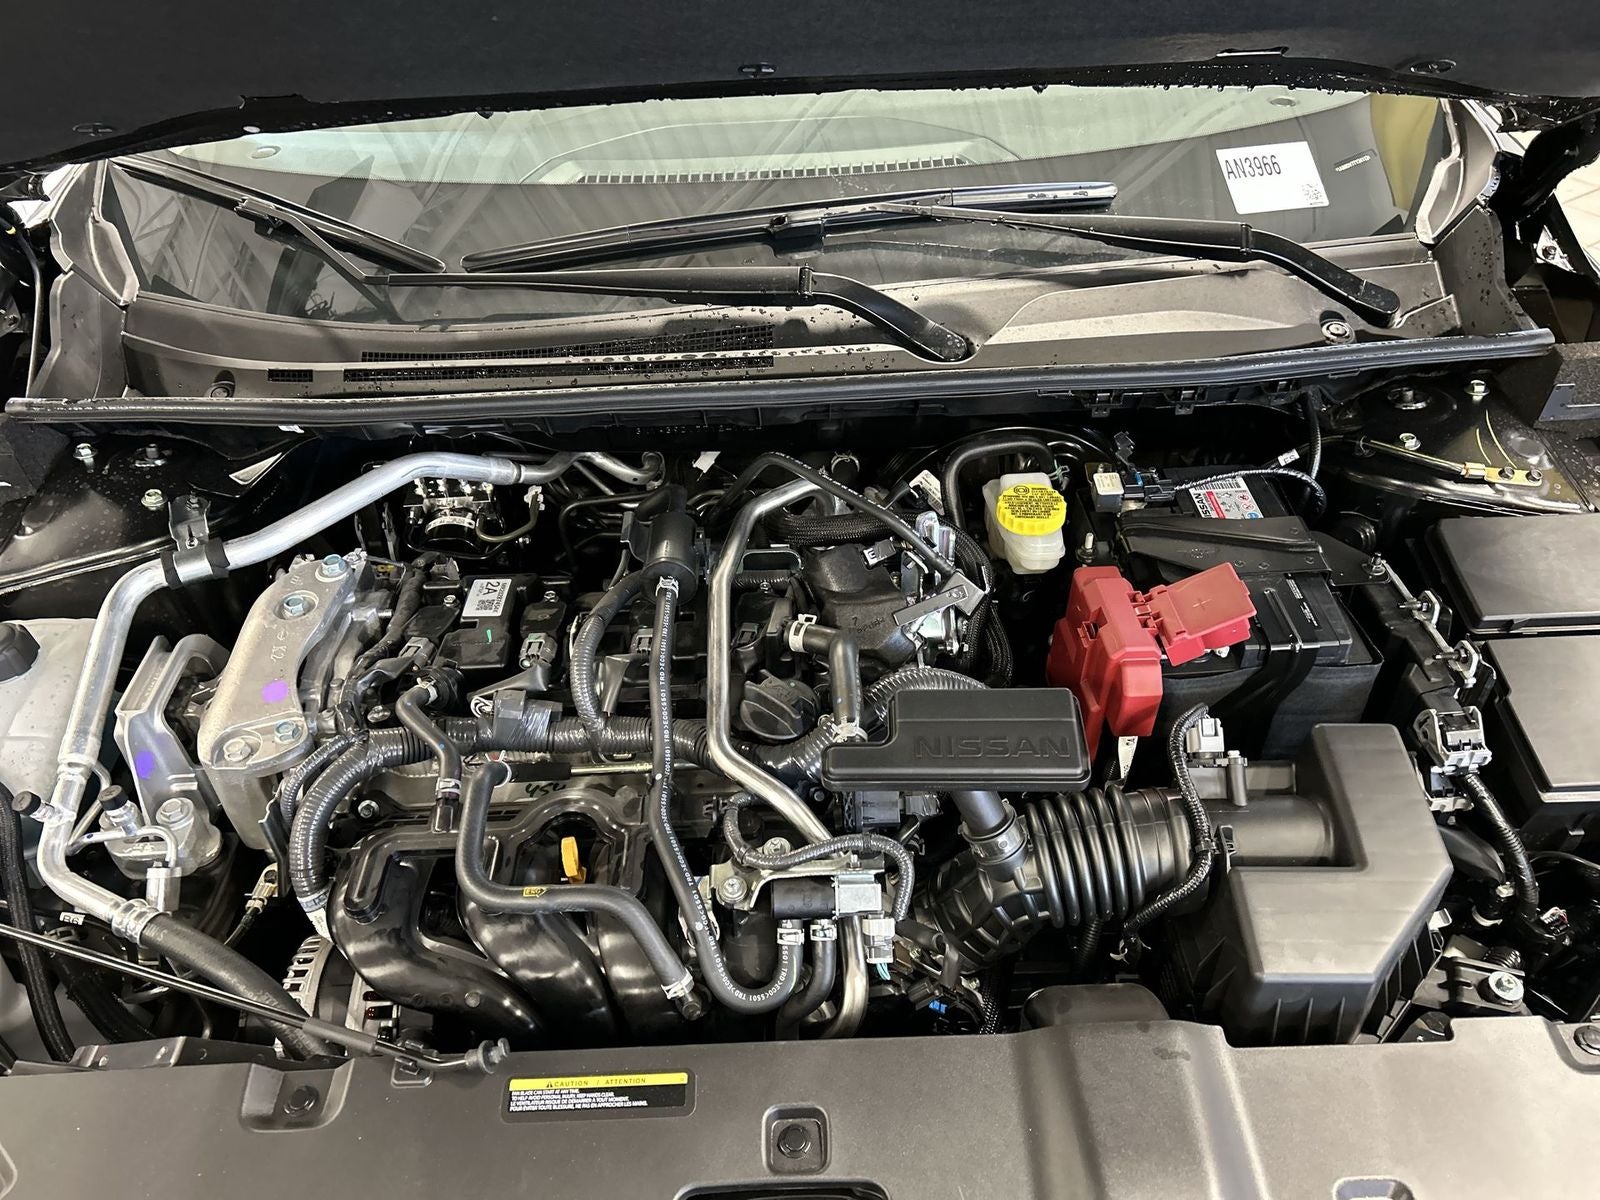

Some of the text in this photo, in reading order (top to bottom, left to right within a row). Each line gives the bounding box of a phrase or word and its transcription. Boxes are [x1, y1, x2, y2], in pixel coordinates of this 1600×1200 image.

[1225, 154, 1282, 180] AN3966
[1193, 491, 1212, 518] ISSAN
[482, 581, 500, 595] 2A
[913, 735, 1071, 758] NISSAN
[605, 1077, 646, 1085] ATTENTION
